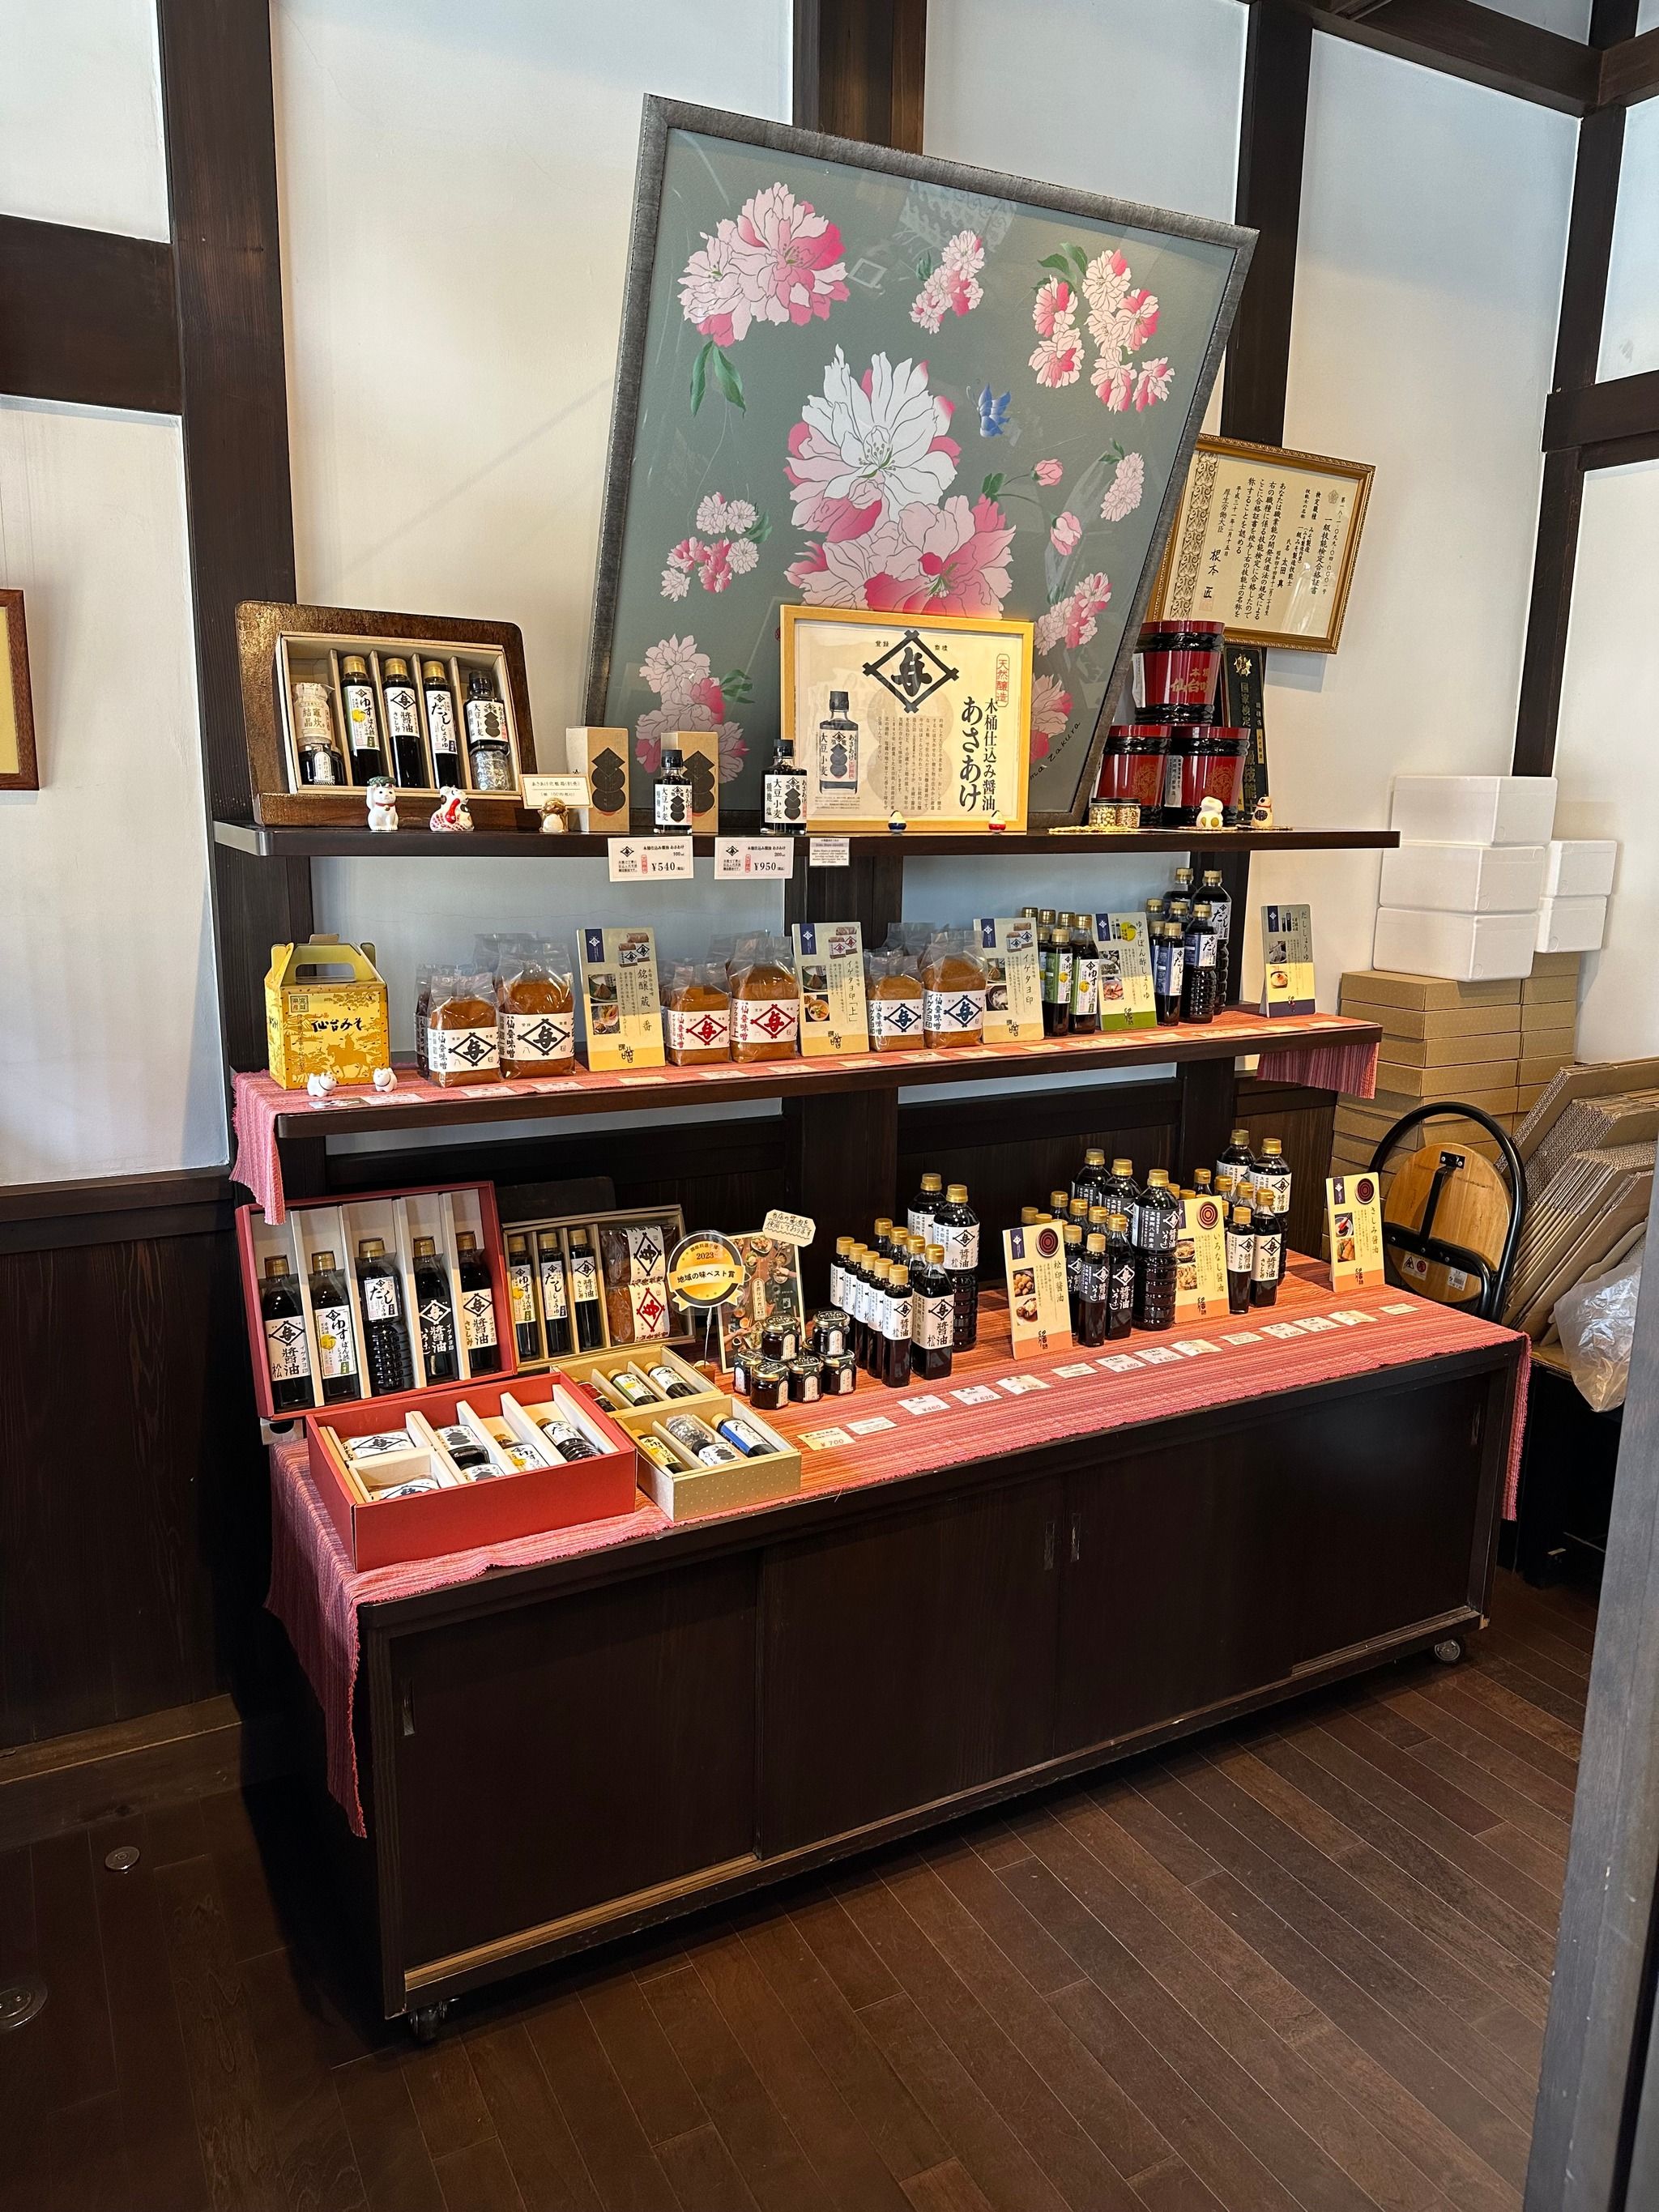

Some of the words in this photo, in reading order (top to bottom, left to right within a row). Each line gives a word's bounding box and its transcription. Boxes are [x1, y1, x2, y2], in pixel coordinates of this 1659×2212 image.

[1236, 477, 1256, 554] 称することを認める
[1207, 548, 1222, 576] 根本
[1254, 483, 1286, 620] あなたは職業能力開発促進法の規定による
[1311, 518, 1333, 595] 一級技能検定合格証書
[1279, 557, 1288, 574] 太田
[959, 696, 983, 812] あさあけ
[982, 697, 998, 811] 木桶仕込み醤油
[661, 786, 669, 821] 大豆小麦
[773, 778, 783, 819] 大豆小麦
[651, 862, 676, 872] ¥540
[754, 862, 777, 871] ¥950
[1212, 909, 1228, 928] だし
[1023, 953, 1034, 1005] イゲタヨ印
[925, 993, 934, 1029] イゲタヨ印
[310, 1016, 362, 1033] 仙台みそ
[1371, 1206, 1379, 1254] さしみ醤油
[696, 1251, 714, 1260] 2023
[951, 1257, 958, 1268] 松
[959, 1248, 970, 1268] 醤油
[1214, 1233, 1225, 1293] いろなし醤油
[1266, 1256, 1277, 1278] 醤油
[676, 1270, 736, 1283] 地域の味ベスト賞
[1053, 1259, 1064, 1303] 松印醤油
[369, 1285, 393, 1305] だし
[1120, 1286, 1131, 1309] 醤油
[429, 1324, 447, 1353] 醤油
[464, 1320, 474, 1346] さしみ
[472, 1318, 488, 1345] 醤油
[893, 1328, 899, 1338] 松
[928, 1334, 936, 1347] 松
[936, 1320, 949, 1346] 醤油
[271, 1362, 283, 1379] 松
[281, 1346, 300, 1376] 醤油
